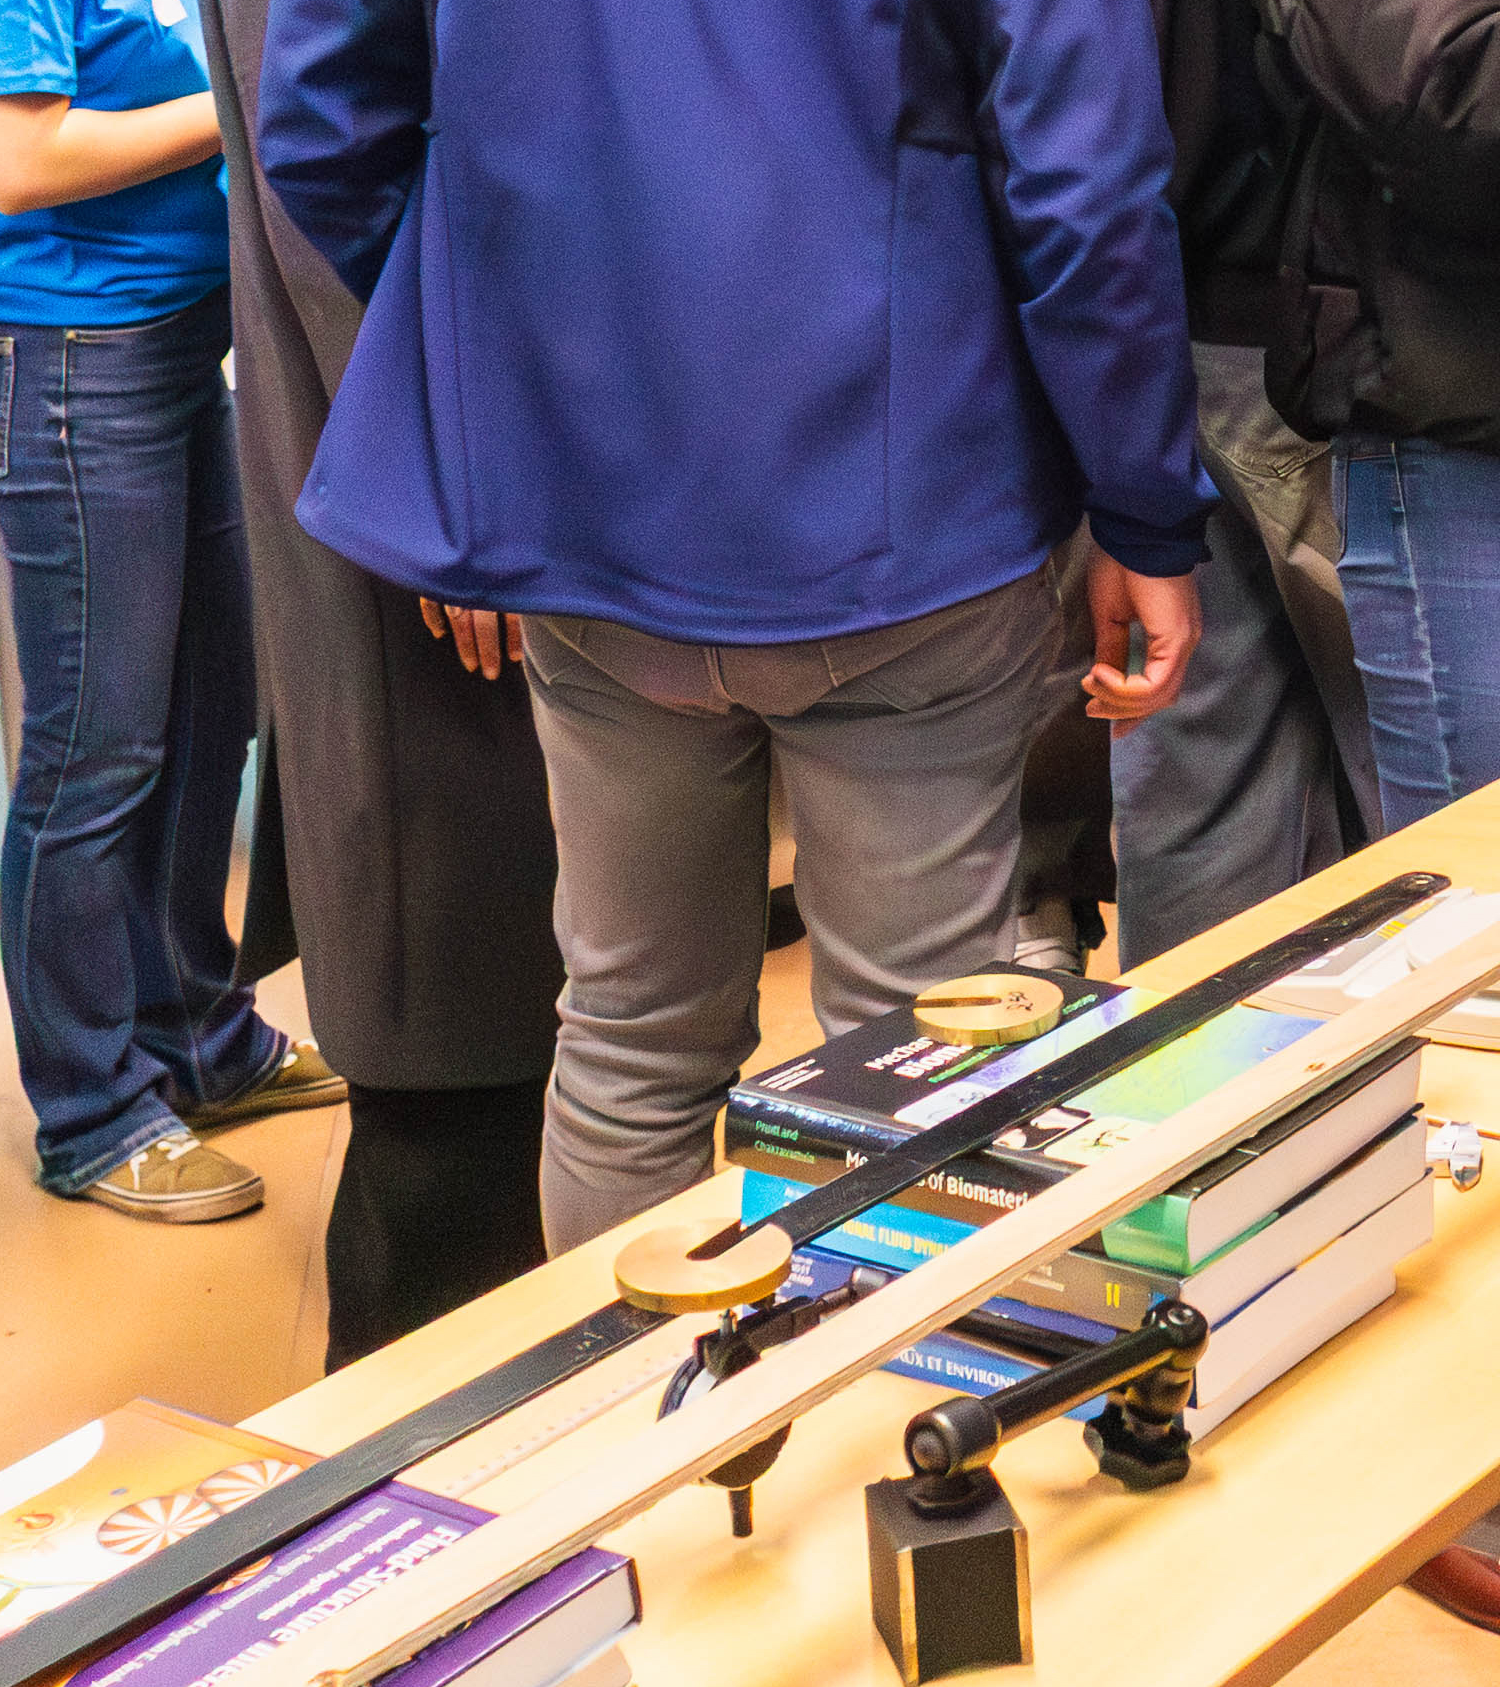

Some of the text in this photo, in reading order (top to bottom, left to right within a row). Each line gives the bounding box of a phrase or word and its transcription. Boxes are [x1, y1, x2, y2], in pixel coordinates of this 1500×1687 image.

[928, 1170, 946, 1192] of
[946, 1175, 1029, 1210] Biomateri
[878, 1226, 912, 1250] FLUID
[913, 1235, 949, 1258] DYNA
[946, 1359, 1017, 1388] ENVIRON
